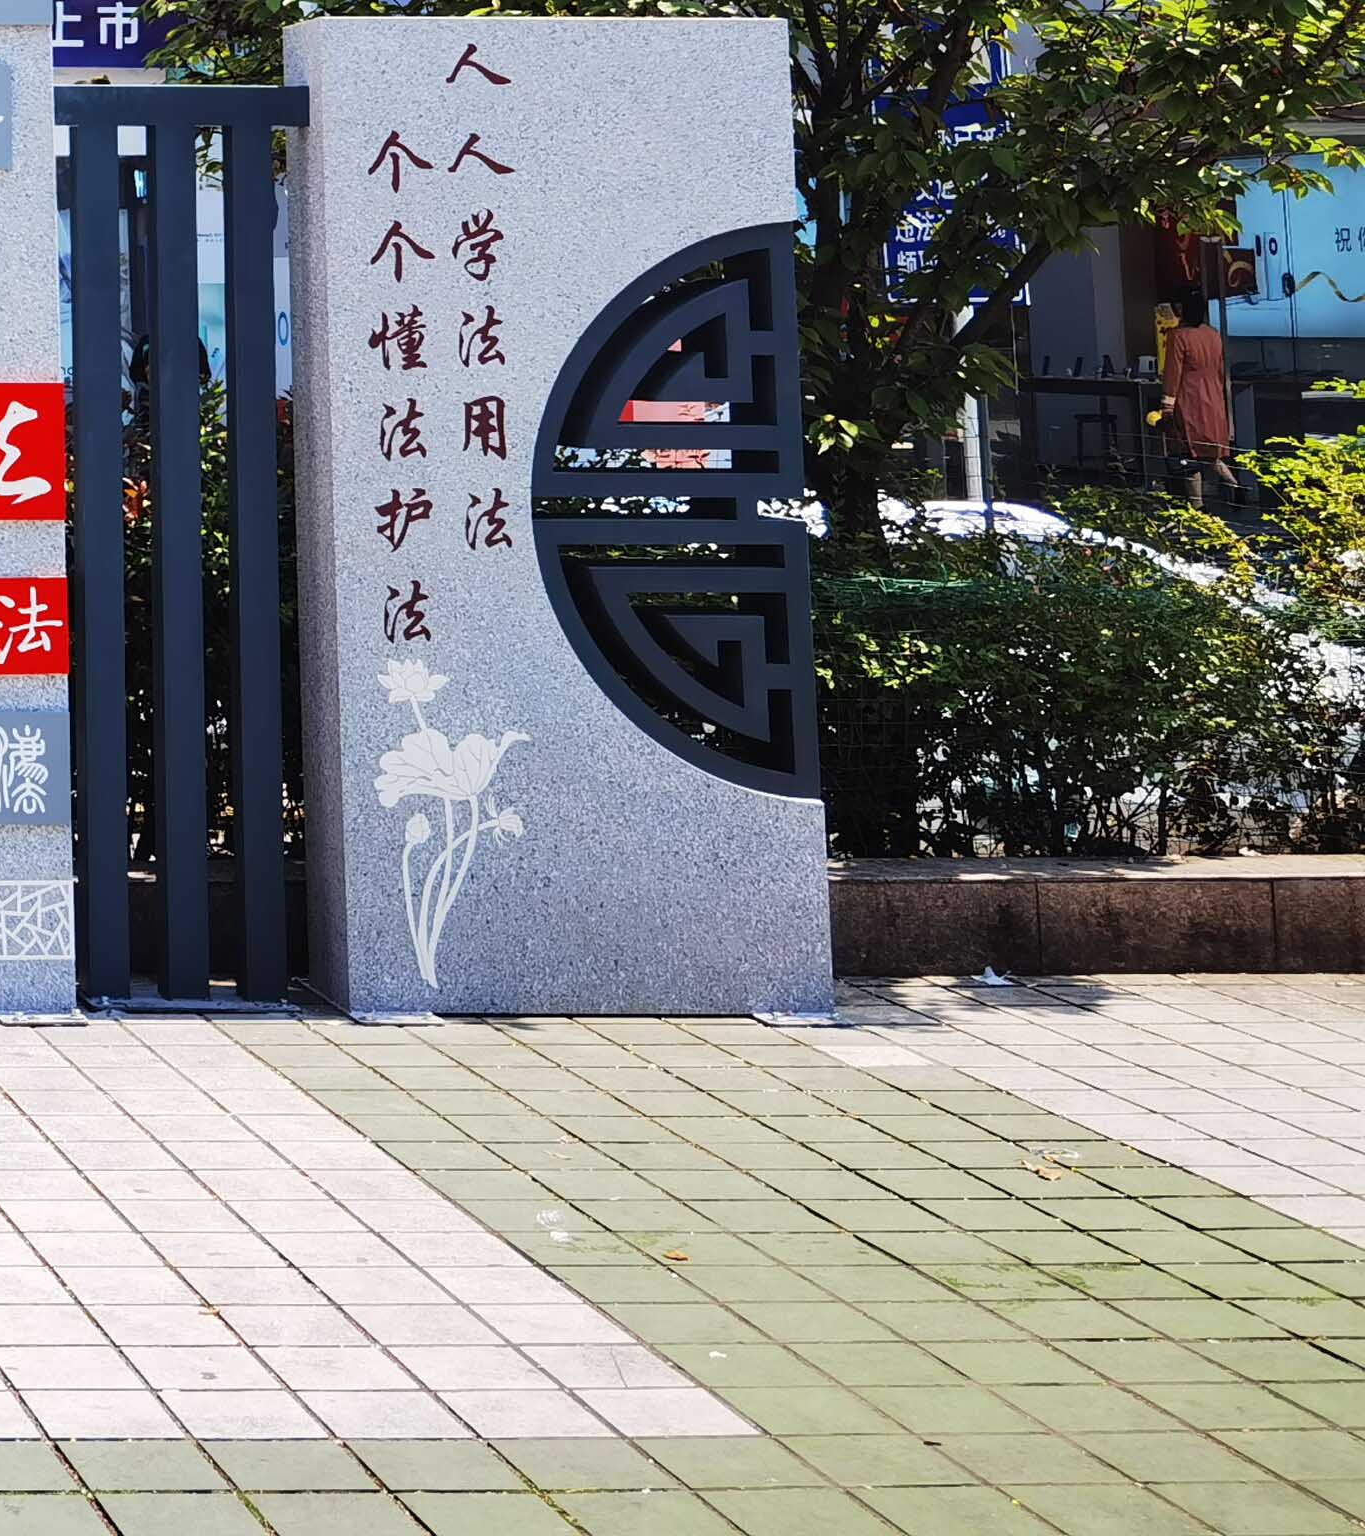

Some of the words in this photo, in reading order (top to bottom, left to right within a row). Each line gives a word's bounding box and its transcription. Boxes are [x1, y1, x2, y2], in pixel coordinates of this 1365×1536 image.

[368, 130, 435, 644] 个个懂法护法
[445, 43, 516, 551] 人人学法用法
